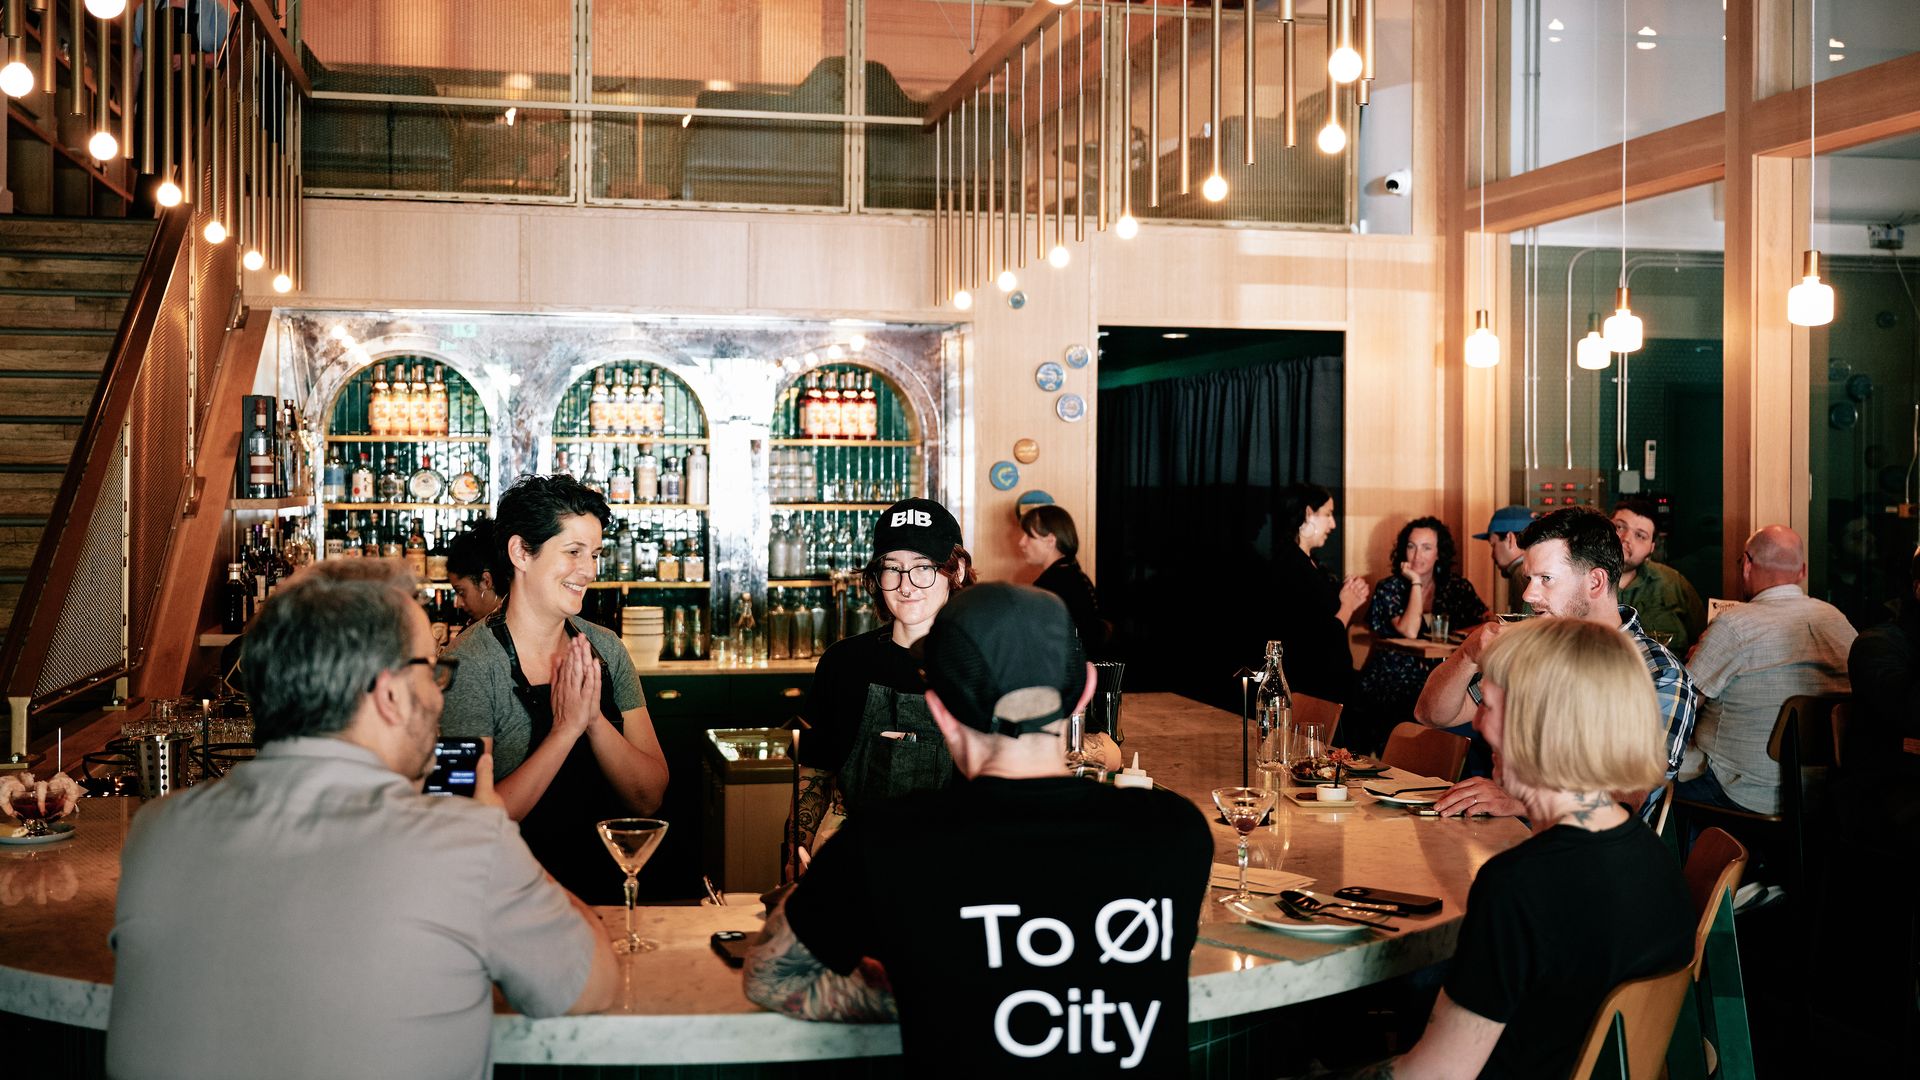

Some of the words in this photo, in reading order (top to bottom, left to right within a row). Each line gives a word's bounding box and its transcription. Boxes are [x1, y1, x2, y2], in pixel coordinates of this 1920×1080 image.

[890, 508, 932, 527] BIB
[960, 905, 1074, 968] To
[1095, 898, 1173, 963] Øl
[995, 988, 1161, 1068] City
